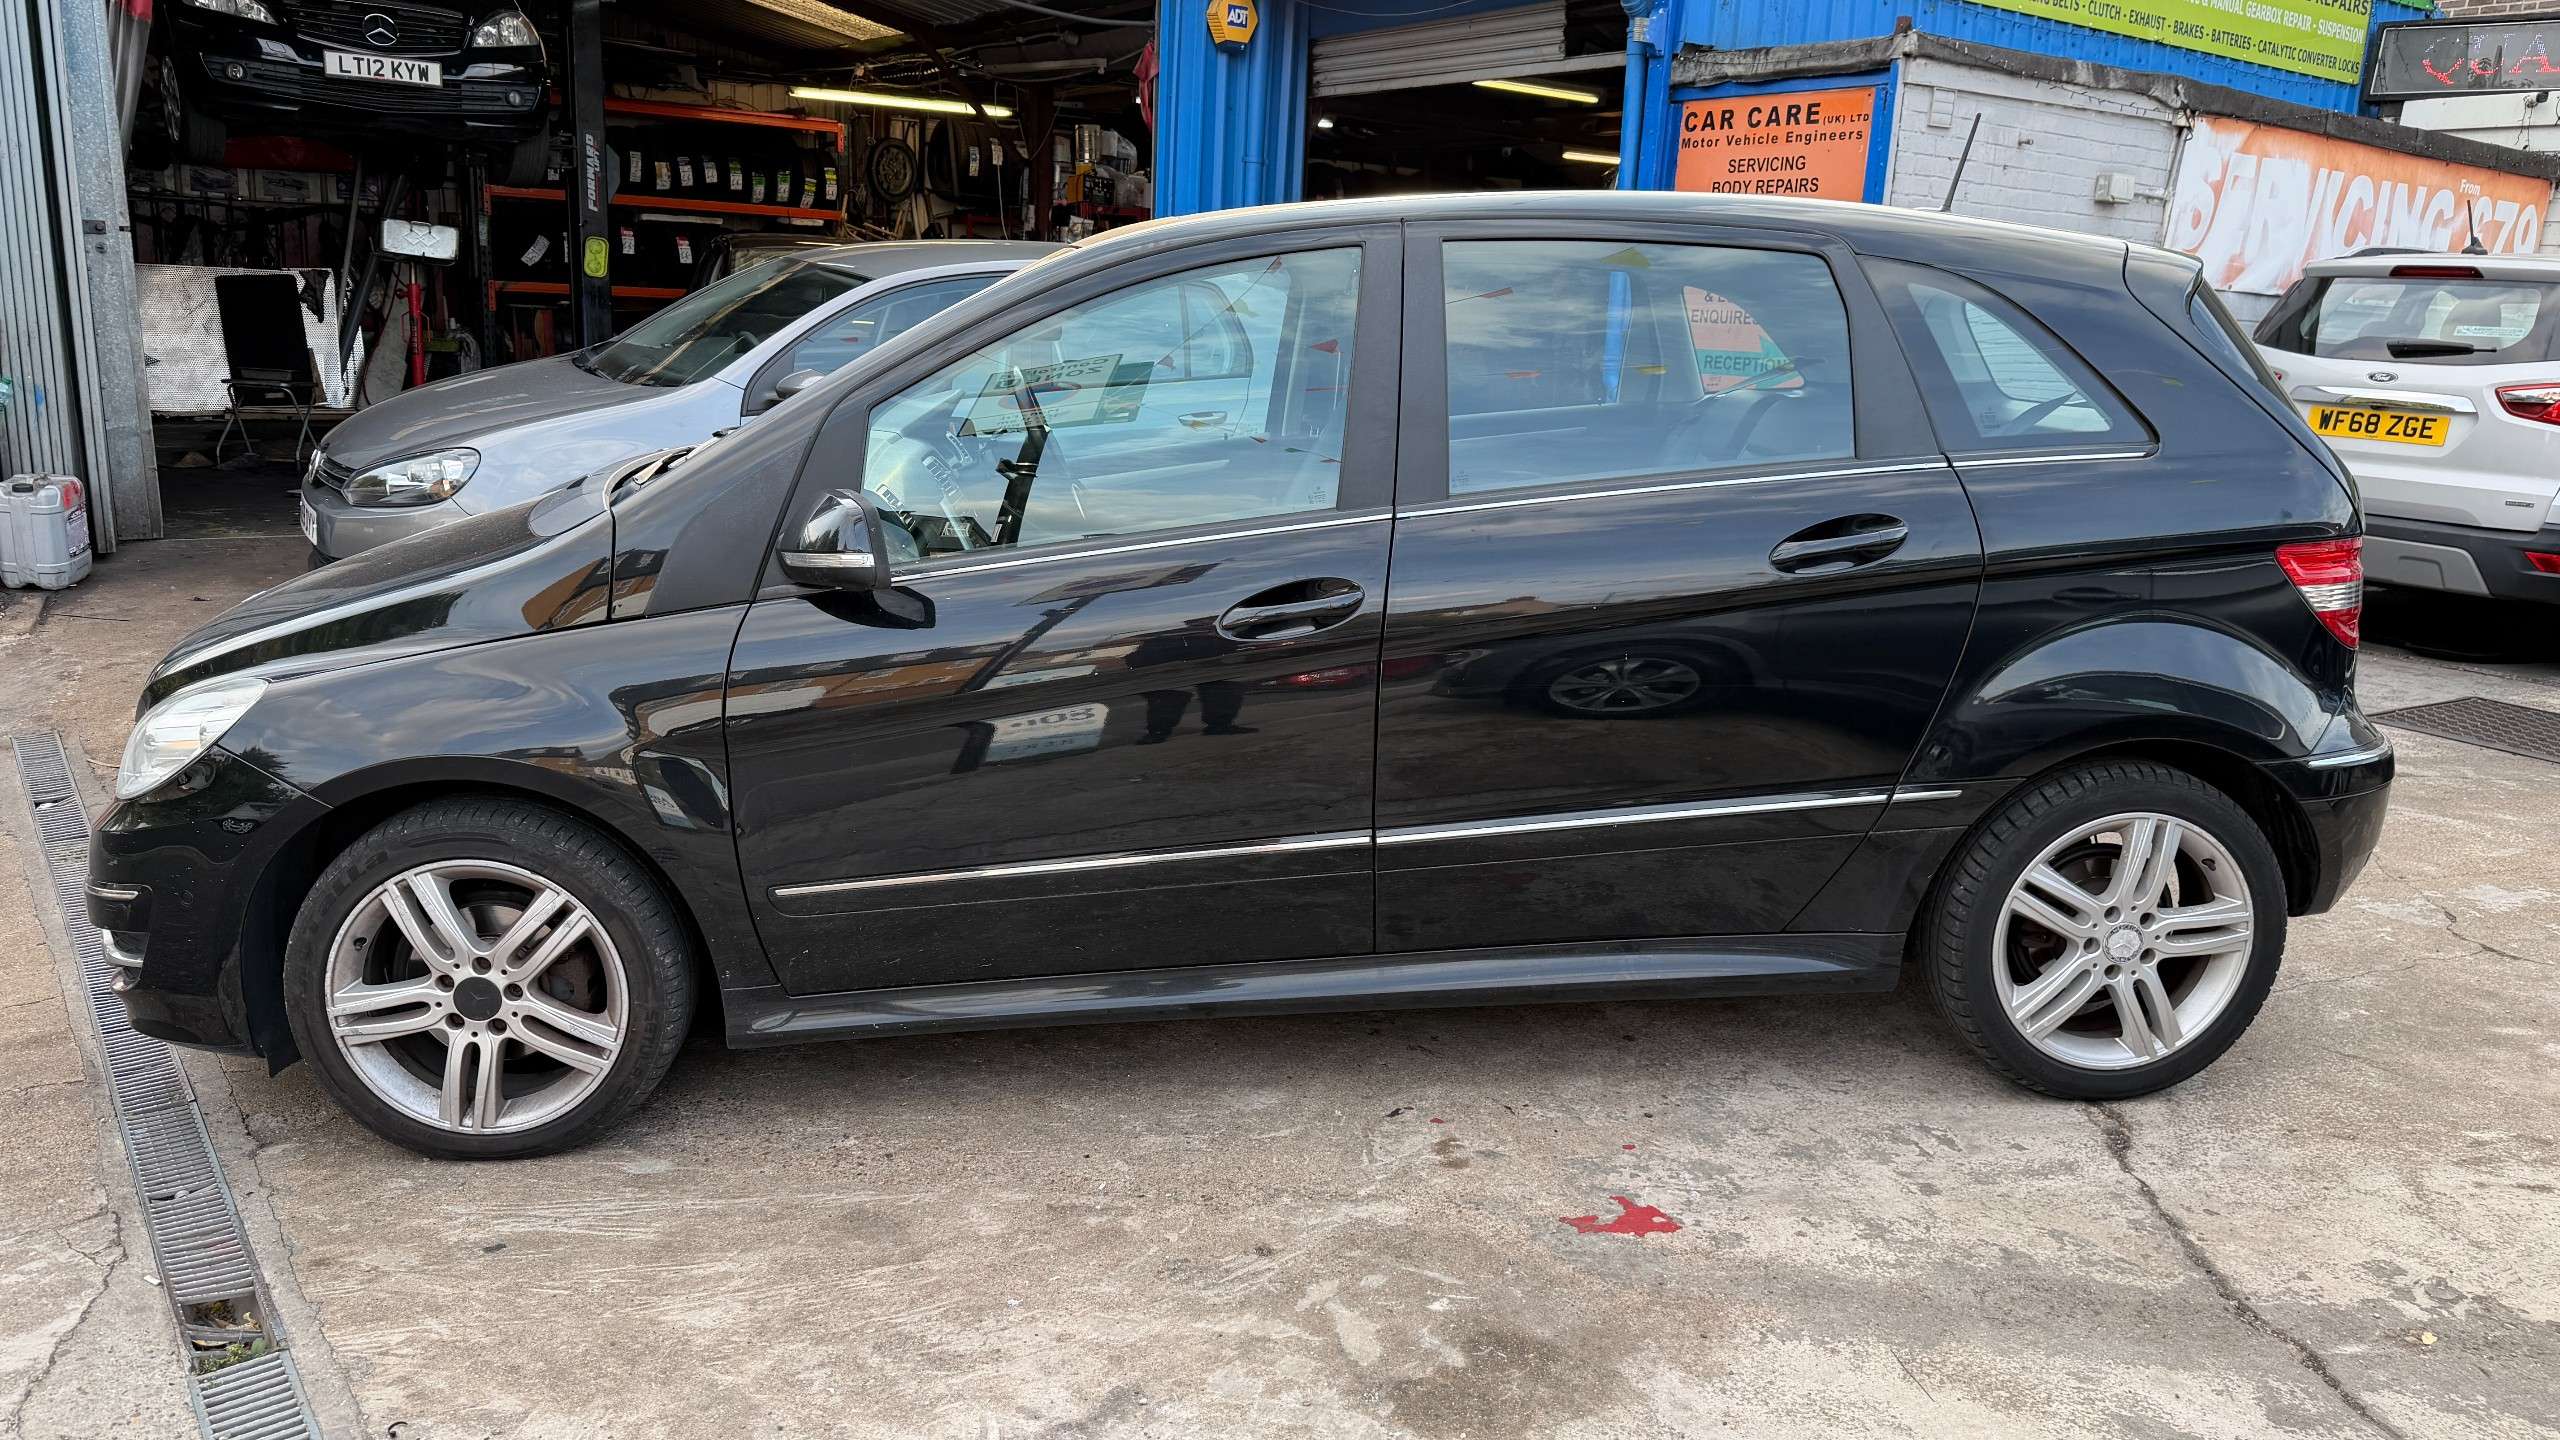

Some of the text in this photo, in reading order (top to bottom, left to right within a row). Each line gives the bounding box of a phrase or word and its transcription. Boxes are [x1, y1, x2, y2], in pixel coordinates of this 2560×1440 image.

[1228, 8, 1249, 25] ADT
[2313, 0, 2369, 16] AIRS
[2246, 1, 2282, 25] GEARBOX
[2283, 9, 2312, 32] REPAIR
[2317, 18, 2364, 44] SUSPENSION
[2088, 0, 2122, 21] CLUTCH
[2128, 9, 2166, 31] EXHAUST
[2173, 20, 2205, 40] BRAKES
[2211, 29, 2252, 50] BATTERIES
[2257, 39, 2297, 61] CATALYTIC
[2297, 49, 2338, 72] CONVERTER
[2338, 59, 2360, 75] LOCKS
[338, 55, 430, 82] LT12 KYW
[1684, 102, 1870, 133] CAR CARE (UK) LTD
[1681, 129, 1864, 150] Motor Vehicle Engineers
[585, 133, 599, 212] FORWARD
[1727, 155, 1806, 174] SERVICING
[1711, 177, 1820, 194] BODY REPAIRS
[2460, 179, 2480, 196] From
[2317, 409, 2438, 440] WF68 ZGE
